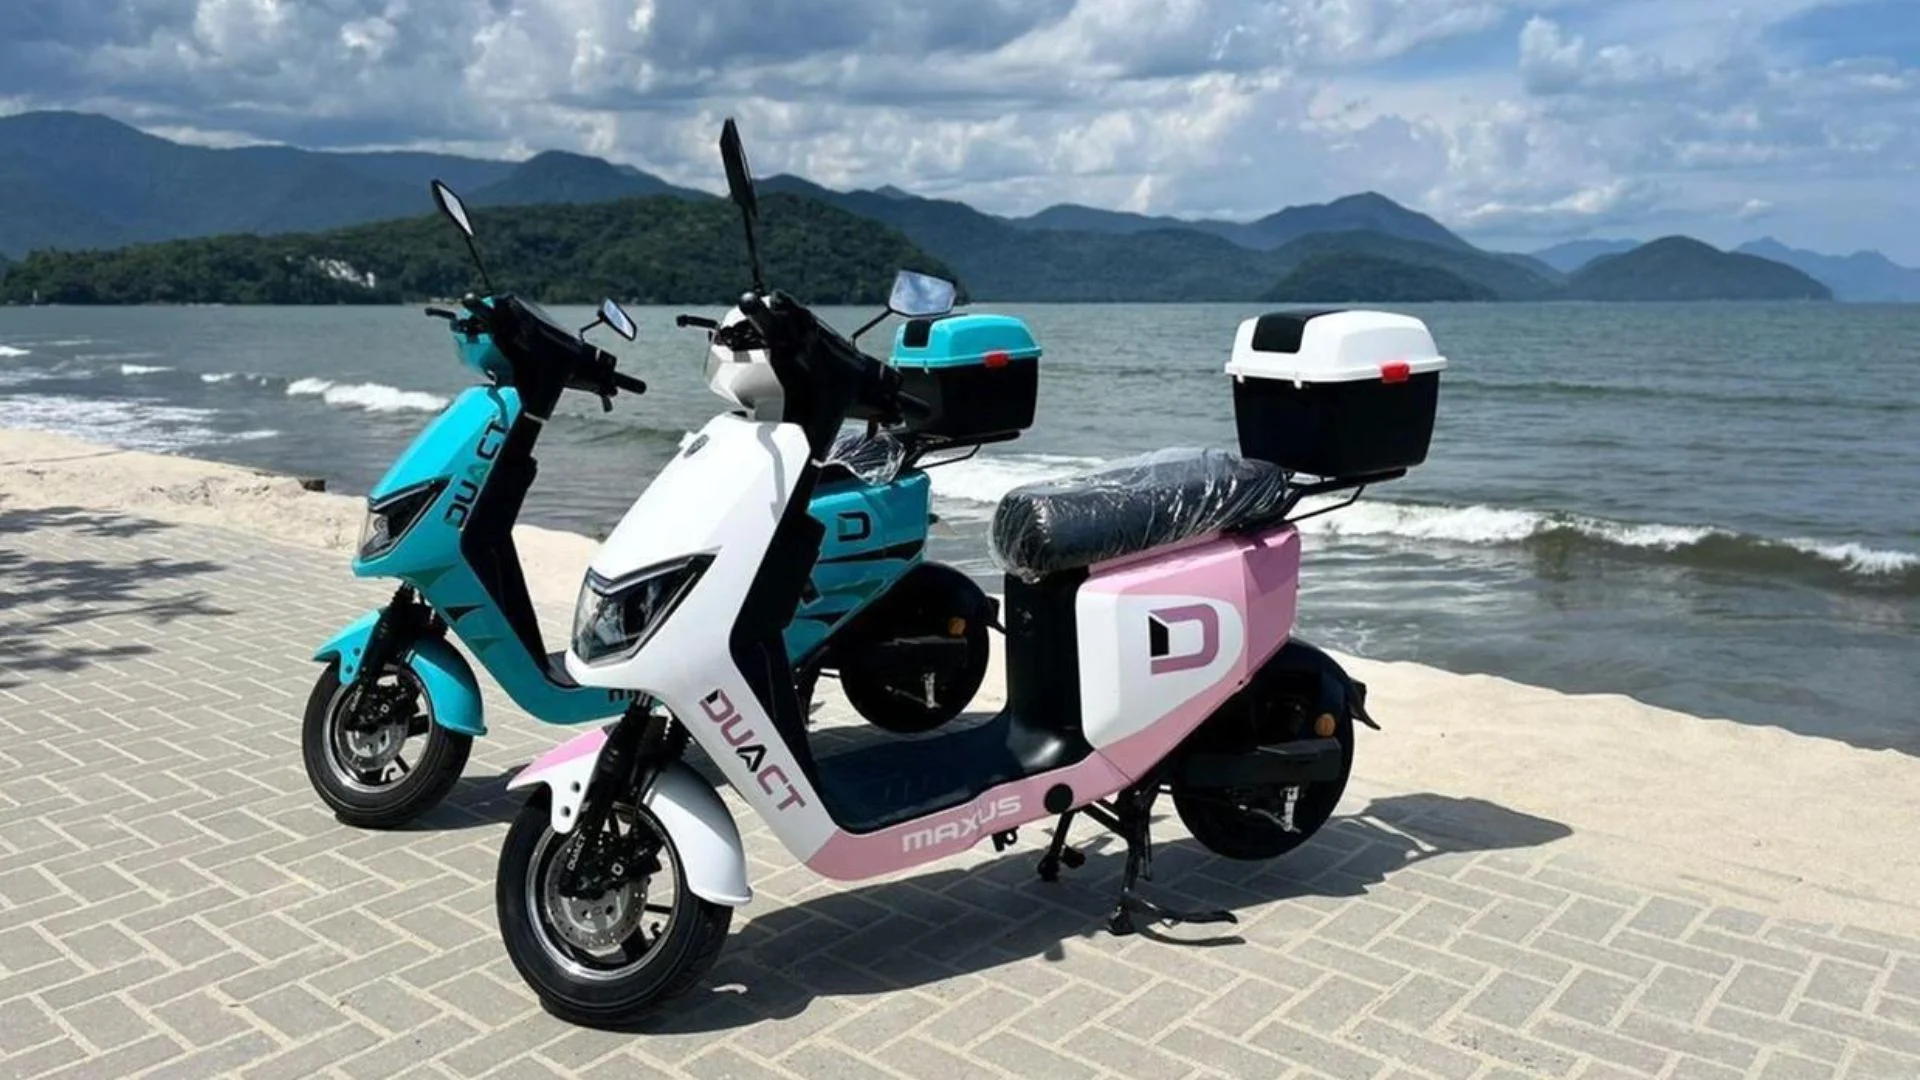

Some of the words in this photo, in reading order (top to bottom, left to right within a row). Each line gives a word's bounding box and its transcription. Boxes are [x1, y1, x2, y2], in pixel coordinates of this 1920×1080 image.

[444, 420, 508, 530] DUACT
[837, 511, 871, 541] D
[1148, 603, 1219, 675] D
[699, 689, 807, 810] DUACT
[902, 795, 1022, 853] MAXUS
